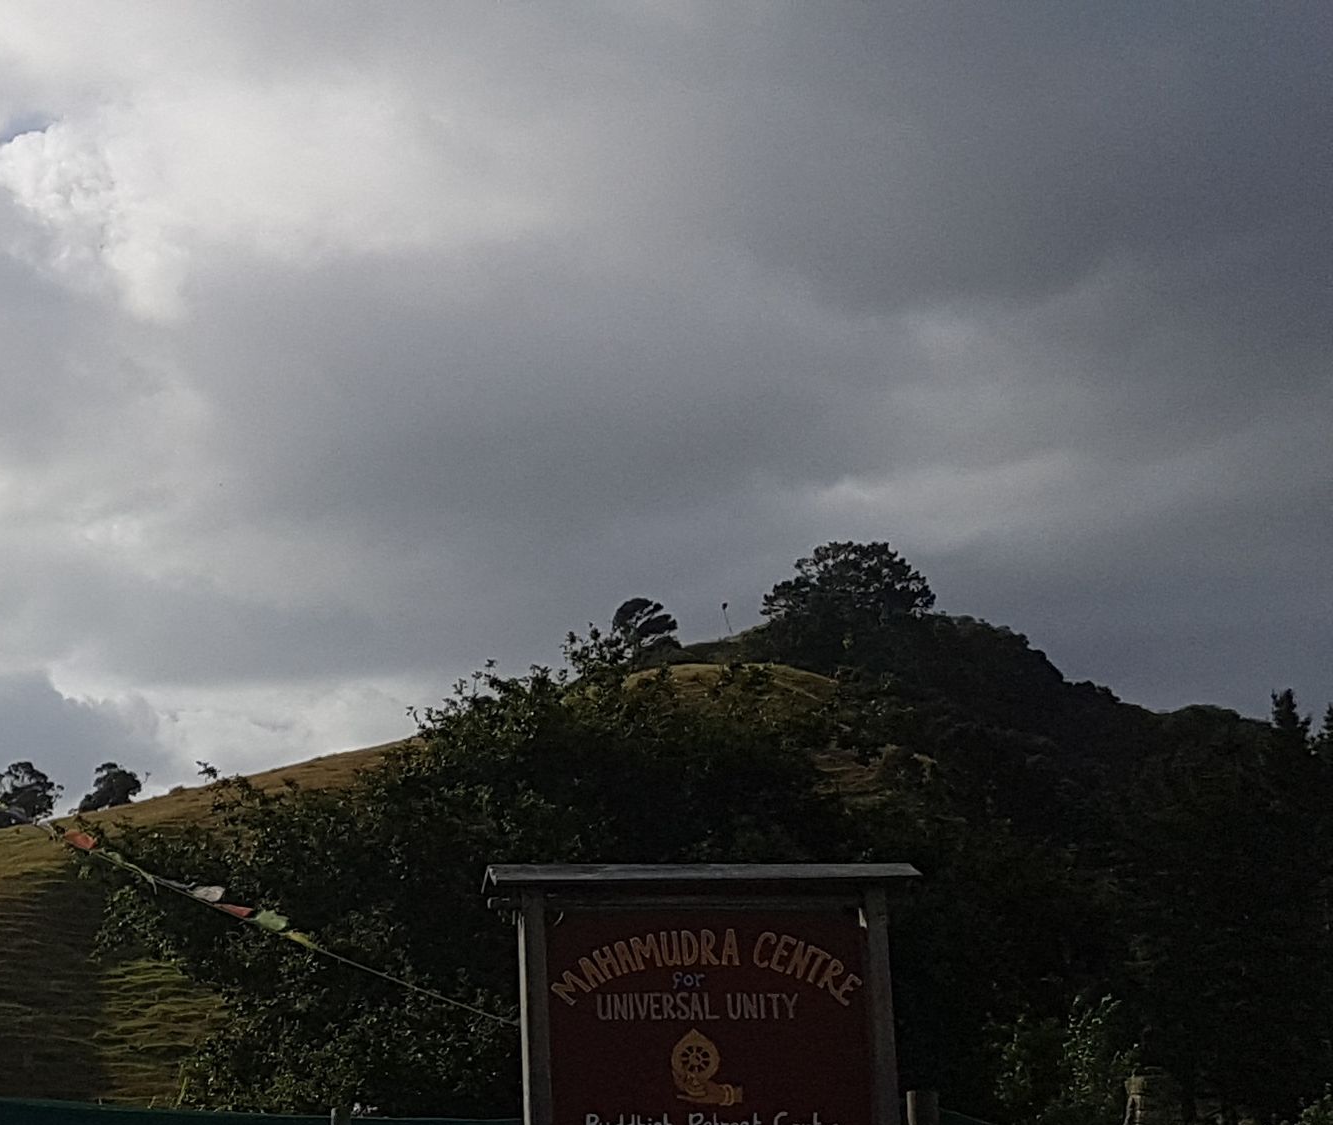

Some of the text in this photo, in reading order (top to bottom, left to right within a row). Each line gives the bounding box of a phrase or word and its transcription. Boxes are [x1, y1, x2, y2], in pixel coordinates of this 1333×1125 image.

[550, 928, 864, 1007] MAHAMUDRA CENTRE
[596, 992, 799, 1021] UNIVERSAL UNITY
